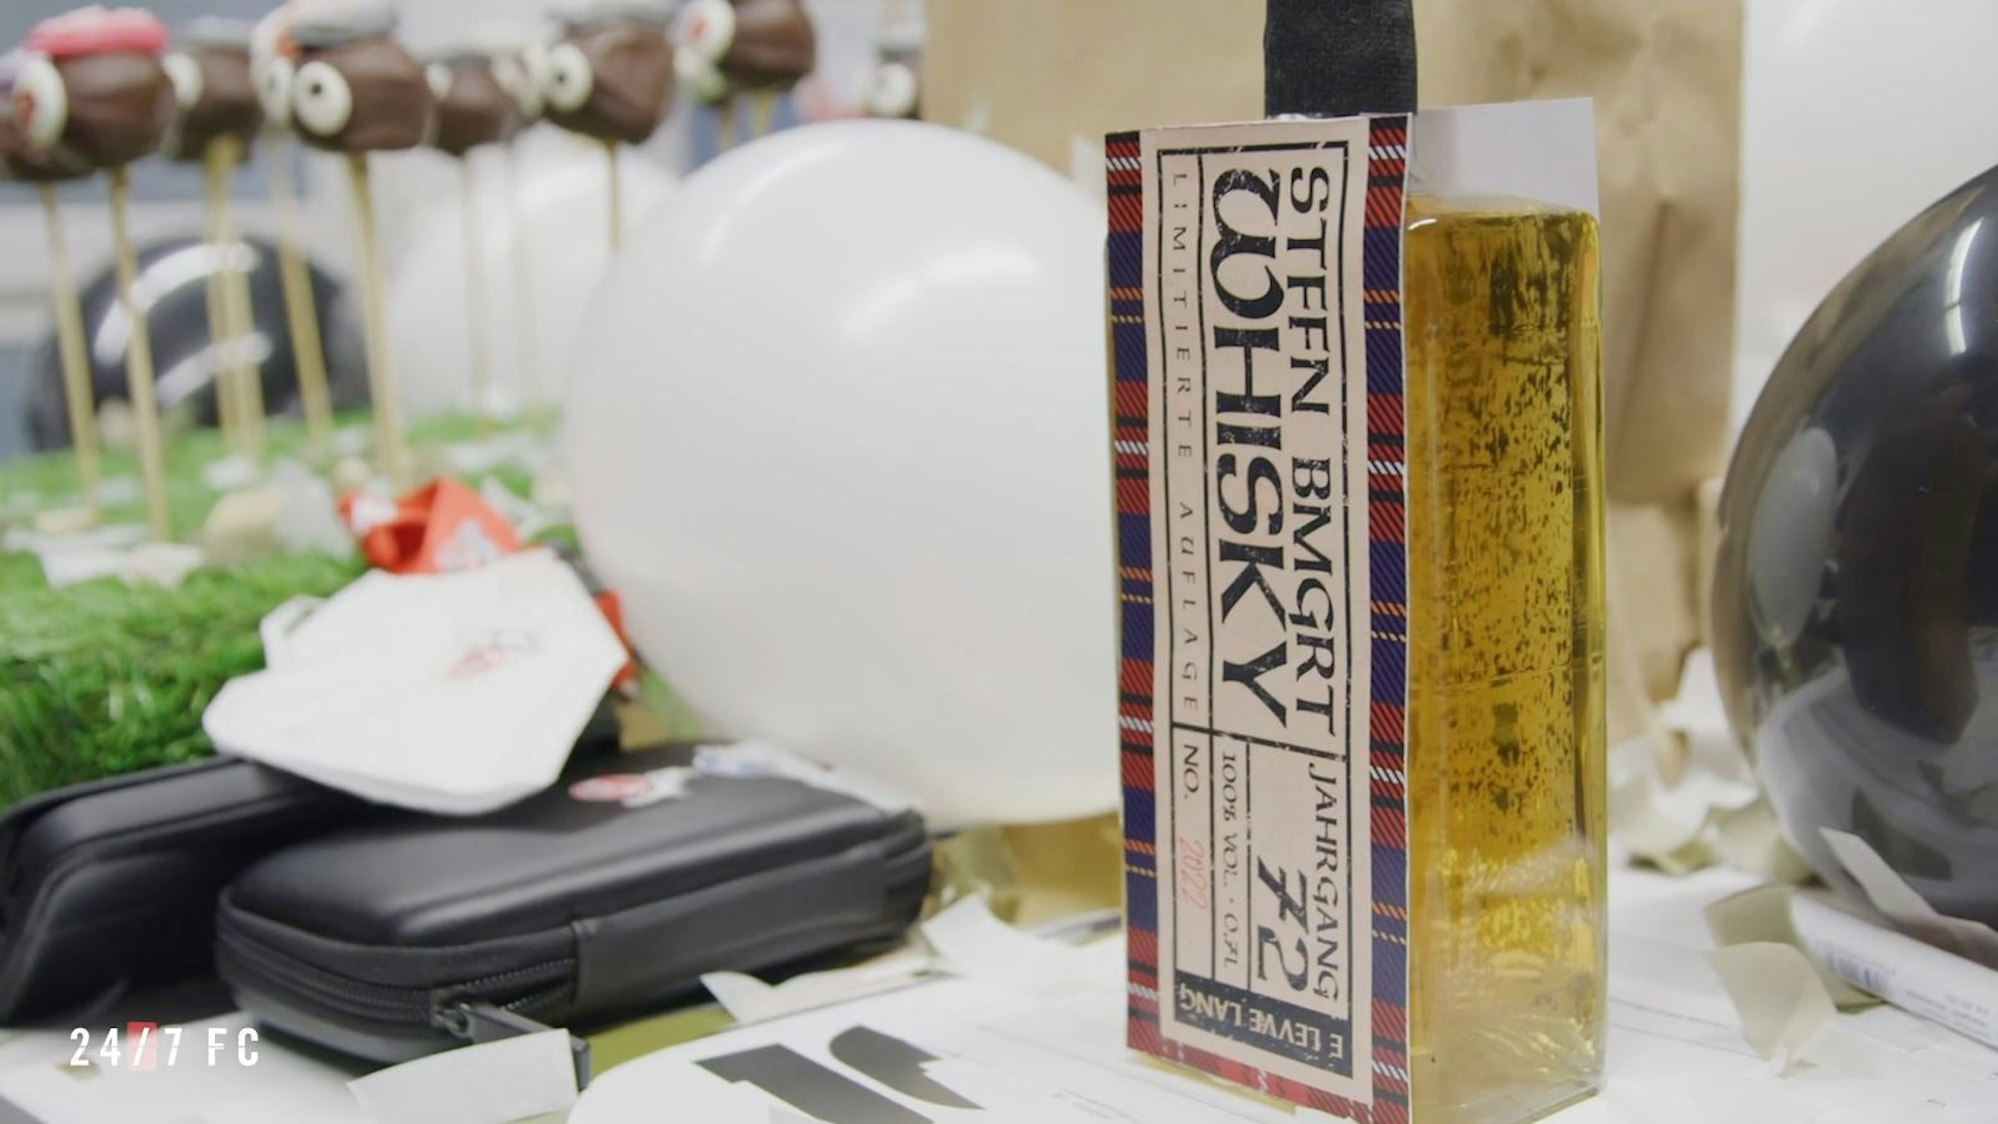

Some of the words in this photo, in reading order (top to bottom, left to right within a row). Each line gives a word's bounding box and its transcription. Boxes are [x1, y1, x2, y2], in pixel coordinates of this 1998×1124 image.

[1173, 173, 1192, 458] LIMITIERTE
[1287, 167, 1330, 416] STFFN
[1210, 168, 1287, 728] WHISKY
[1179, 501, 1199, 712] AUFLAGE
[1288, 456, 1335, 736] BMGRT
[1182, 743, 1200, 799] NO.
[1222, 752, 1238, 822] 100%
[1179, 836, 1208, 910] 2022
[1222, 833, 1238, 887] VOL.
[1308, 762, 1339, 1002] JAHRGANG
[1257, 855, 1309, 992] 72
[1179, 983, 1242, 1027] LANG
[1248, 1008, 1322, 1052] LEVVE
[1329, 1032, 1344, 1059] E
